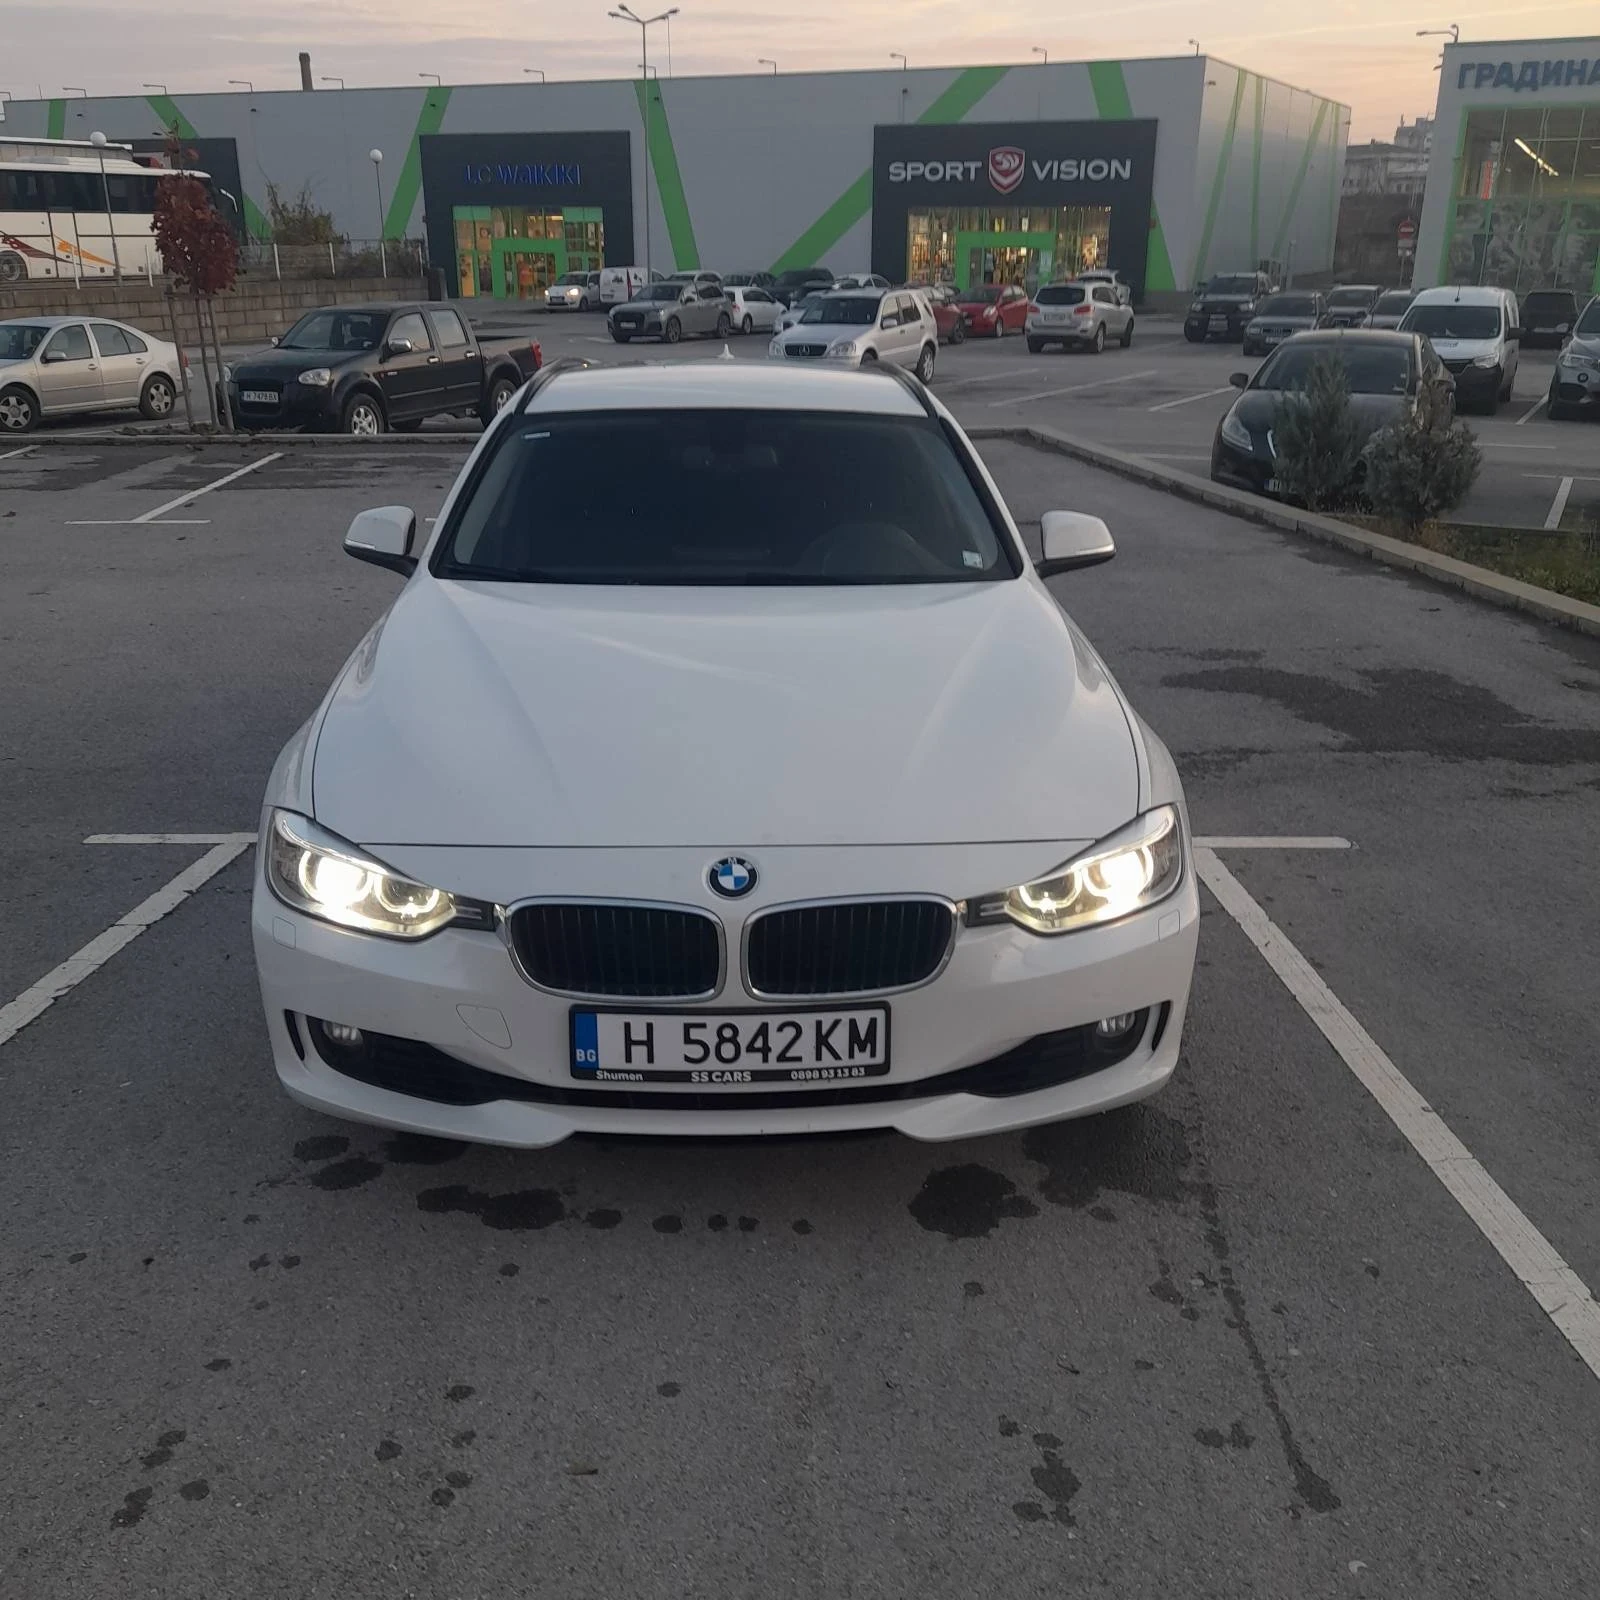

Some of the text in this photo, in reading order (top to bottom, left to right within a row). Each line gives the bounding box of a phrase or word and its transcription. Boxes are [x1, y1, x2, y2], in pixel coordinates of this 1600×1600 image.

[1458, 58, 1600, 92] ГРАДИНА
[888, 158, 1132, 182] SPORT VISION
[576, 1049, 597, 1062] BG
[624, 1021, 655, 1064] H
